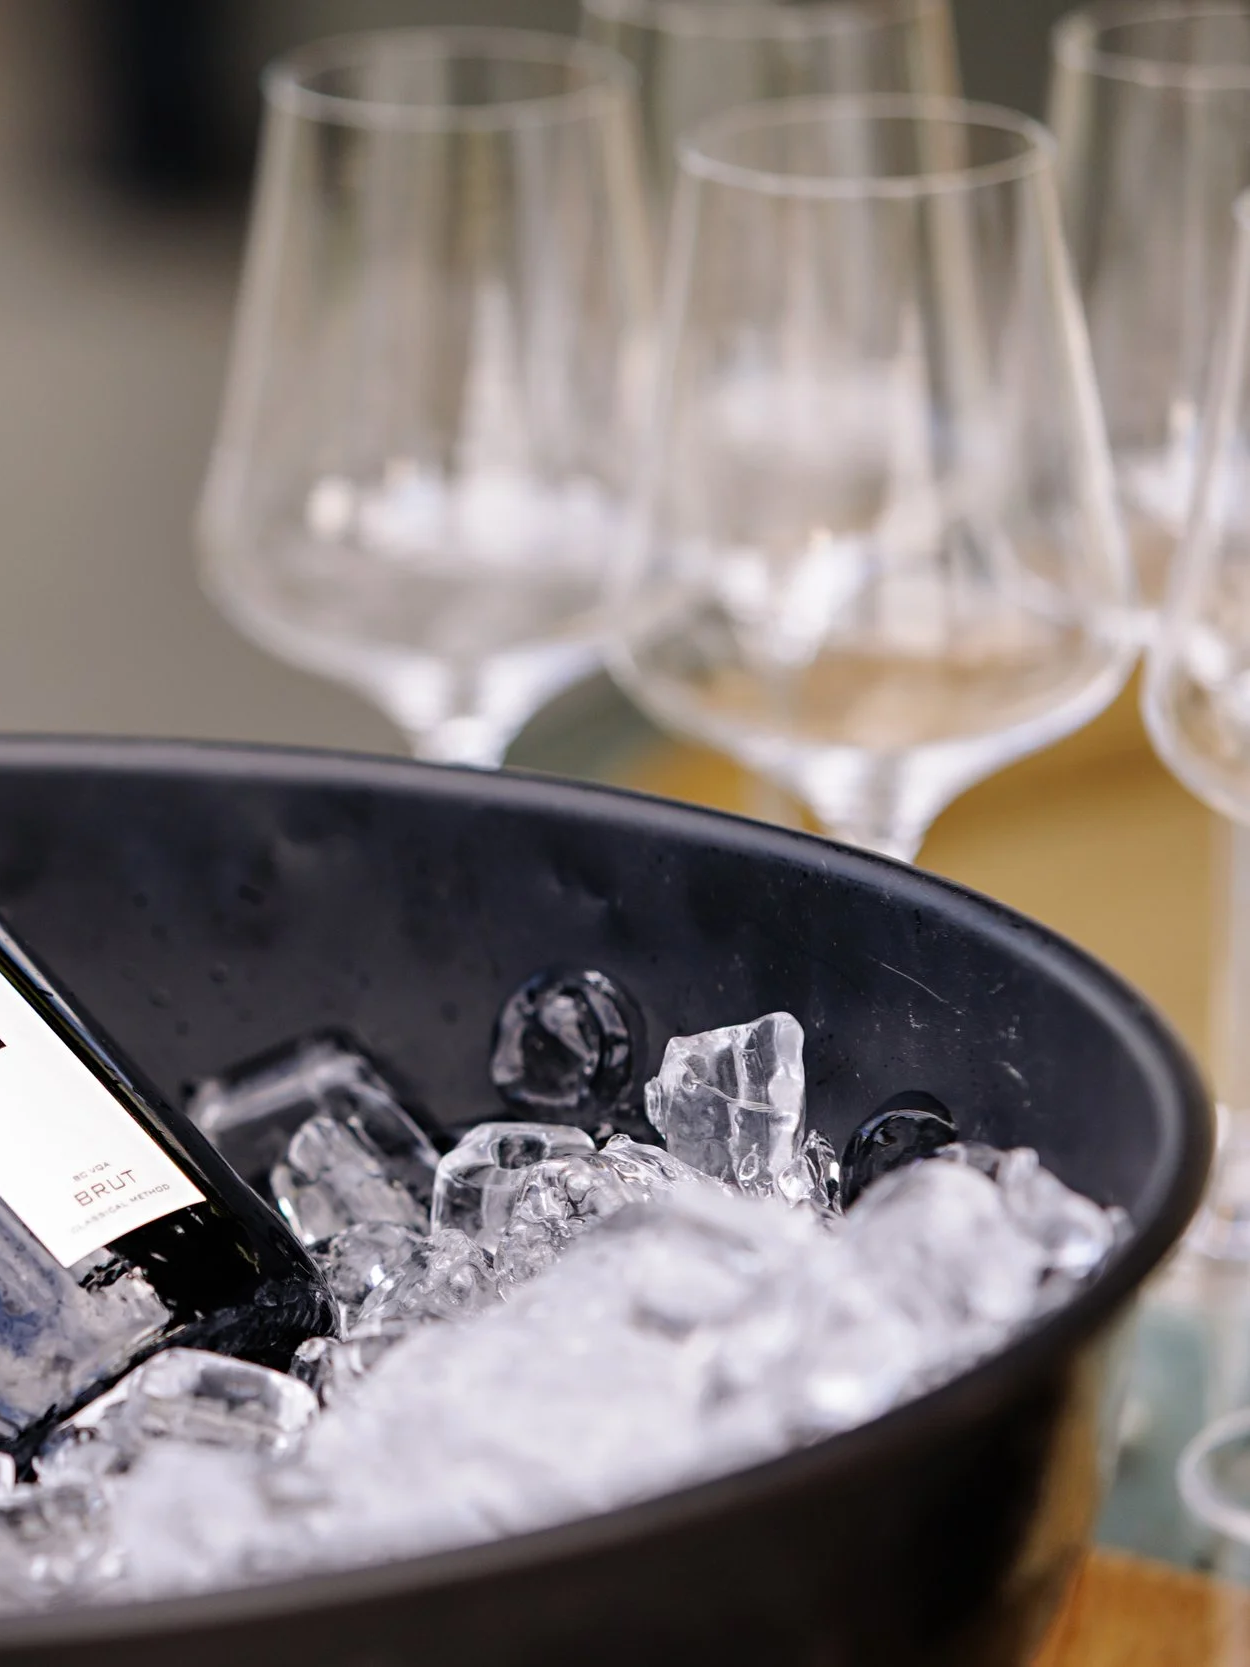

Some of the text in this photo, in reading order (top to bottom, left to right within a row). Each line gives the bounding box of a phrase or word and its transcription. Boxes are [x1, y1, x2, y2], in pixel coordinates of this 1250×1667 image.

[89, 1161, 111, 1174] VQA
[74, 1169, 136, 1207] BRUT
[129, 1183, 171, 1202] METHOD
